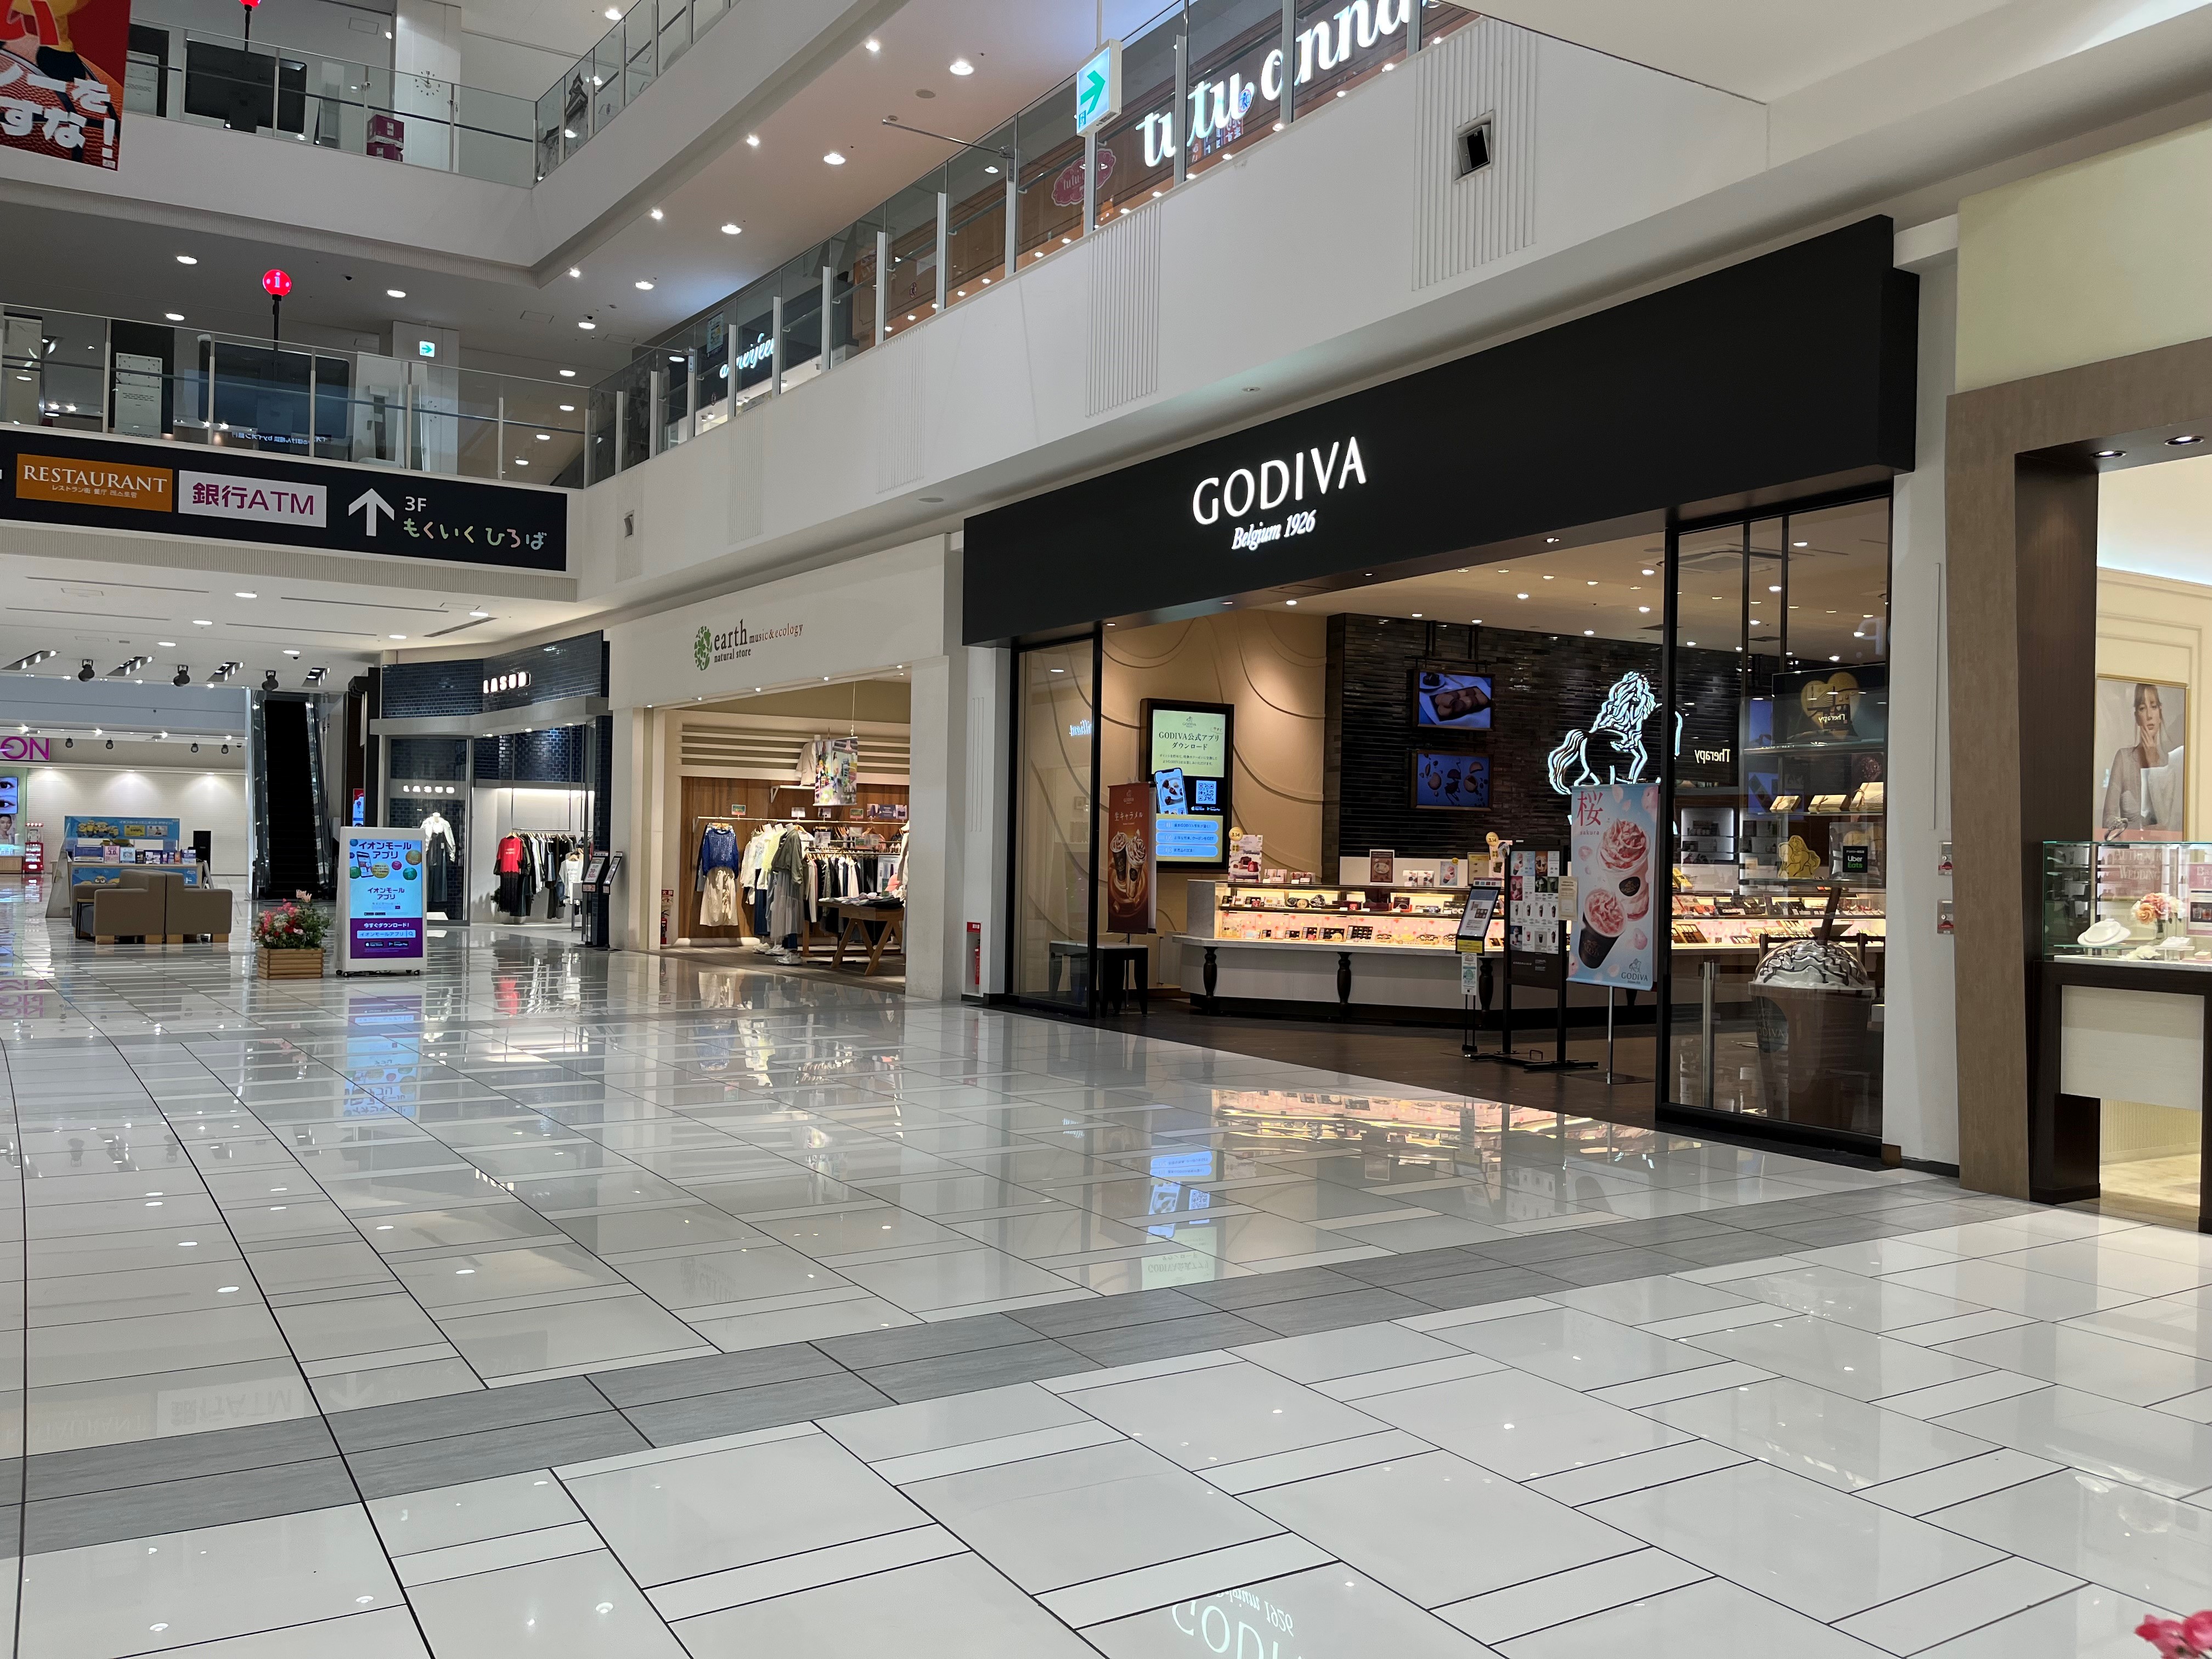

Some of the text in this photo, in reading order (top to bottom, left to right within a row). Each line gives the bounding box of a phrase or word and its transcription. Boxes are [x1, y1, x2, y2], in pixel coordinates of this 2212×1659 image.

[24, 465, 167, 493] RESTAURANT
[1192, 436, 1367, 526] GODIVA
[192, 482, 314, 516] 銀行ATM
[405, 496, 427, 512] 3F
[1231, 509, 1317, 551] Belgium 1926
[714, 618, 748, 651] earth
[714, 648, 752, 663] natural store
[1159, 731, 1219, 742] GODIVA公式アプリ
[1172, 742, 1208, 751] ダウンロード
[1577, 789, 1604, 826] 桜
[1114, 811, 1143, 821] 生キャラメル
[359, 842, 412, 850] イオンモール
[373, 851, 399, 859] アプリ
[1621, 972, 1649, 981] GODIVA
